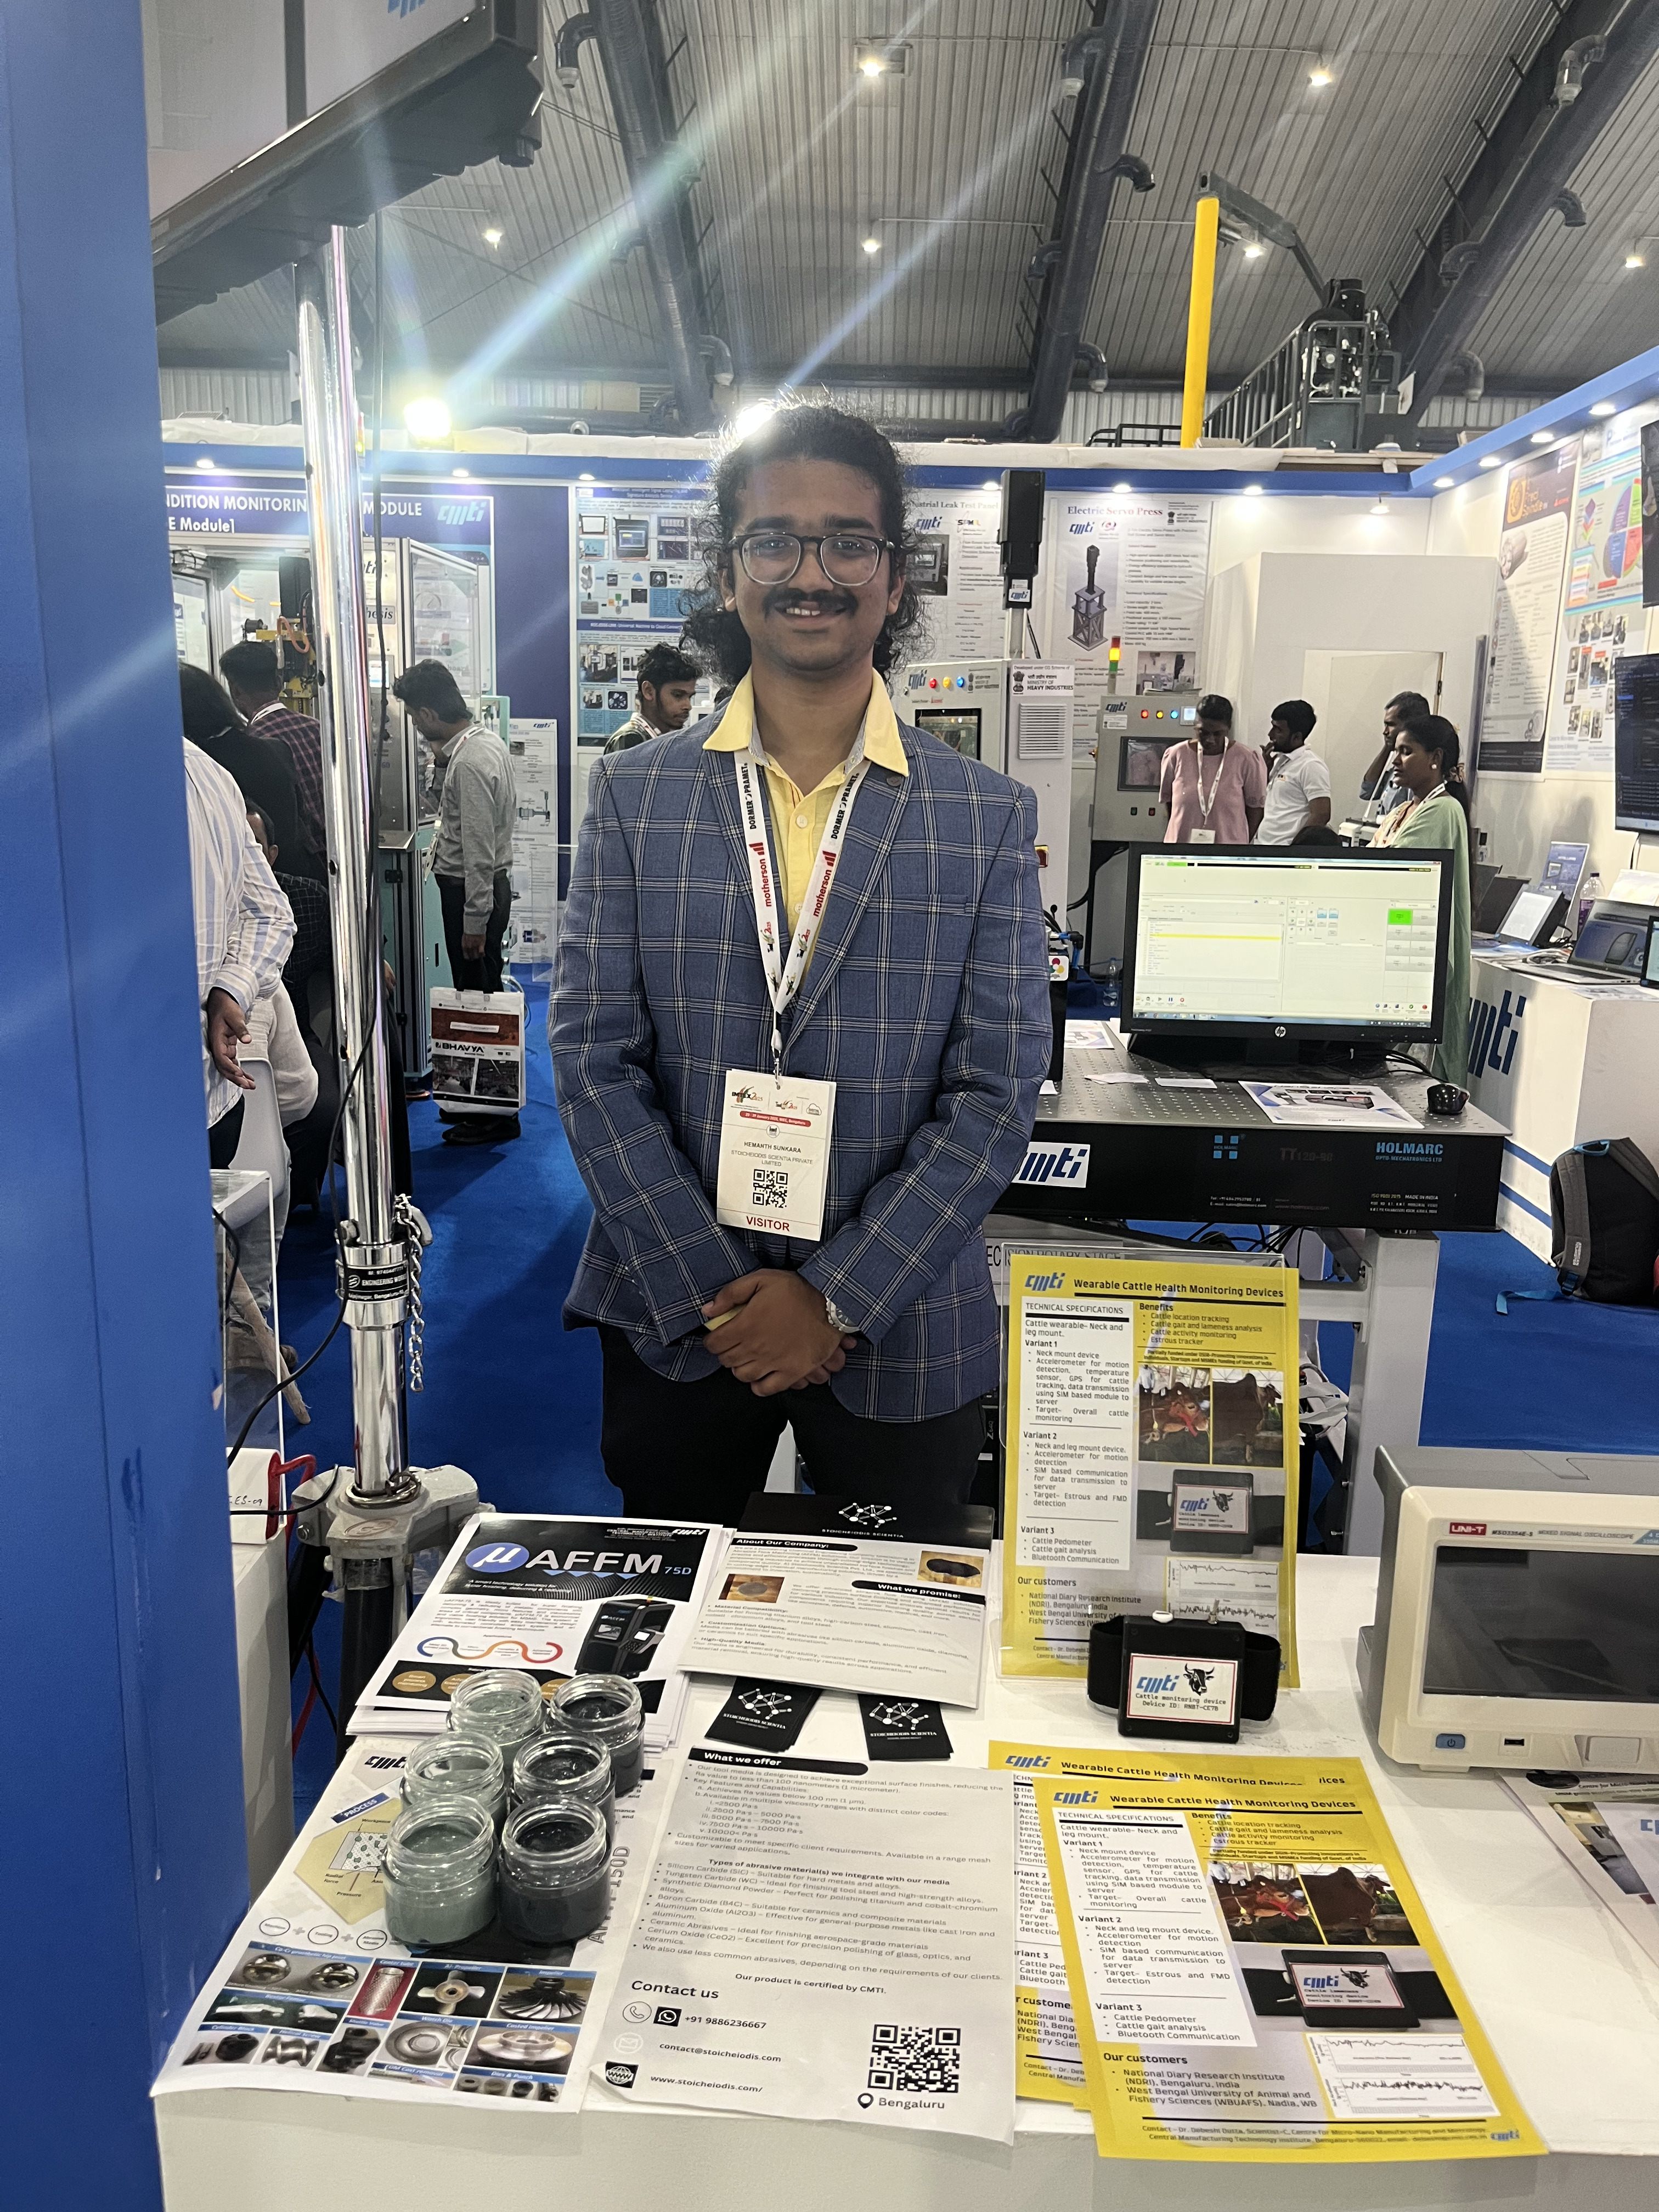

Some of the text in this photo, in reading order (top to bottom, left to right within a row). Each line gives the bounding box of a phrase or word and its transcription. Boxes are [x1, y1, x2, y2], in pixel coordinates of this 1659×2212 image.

[224, 496, 308, 512] MONITORIN
[1068, 506, 1163, 516] Electric Servo Press
[437, 501, 487, 525] cmti
[1069, 522, 1093, 535] cmti
[1010, 590, 1028, 601] cmti
[1105, 702, 1127, 712] cmti
[746, 800, 757, 830] DORMER
[831, 810, 845, 839] DORMER
[759, 859, 772, 907] motherson
[813, 870, 832, 917] motherson
[1275, 1028, 1285, 1037] hp
[1467, 989, 1526, 1079] mti
[442, 1043, 484, 1053] BHAVYA
[1376, 1142, 1443, 1155] HOLMARC
[1018, 1148, 1088, 1182] mti
[746, 1216, 789, 1232] VISITOR
[1025, 1272, 1065, 1291] cmti
[1074, 1279, 1284, 1297] Wearable Cattle Health Monitoring Devices
[1066, 1305, 1123, 1314] SPECIFICATIONS
[1139, 1303, 1173, 1311] Benefits
[1173, 1322, 1186, 1330] gait
[1021, 1526, 1048, 1534] Variant
[1451, 1525, 1485, 1534] UNI-T
[525, 1549, 663, 1573] AFFM
[664, 1566, 692, 1575] 75D
[1067, 1555, 1119, 1564] Communication
[922, 1588, 961, 1599] promise:
[1136, 1675, 1180, 1693] cmti
[1162, 1696, 1200, 1704] monitoring
[364, 1756, 408, 1769] cmt
[704, 1752, 733, 1763] What
[753, 1757, 782, 1767] offer
[1005, 1755, 1052, 1769] cmti
[1053, 1790, 1099, 1804] cmti
[1110, 1795, 1164, 1805] Wearable
[1205, 1797, 1243, 1807] Health
[1245, 1800, 1308, 1809] Monitoring
[1311, 1800, 1356, 1809] Devices
[344, 1799, 377, 1818] PROCESS
[650, 1918, 729, 1932] Ceramic Abrasives
[631, 1980, 720, 2000] Contact us
[754, 1975, 792, 1985] product
[804, 1979, 843, 1990] certified
[845, 1984, 857, 1993] by
[685, 2015, 767, 2030] +91 9886236667
[659, 2042, 782, 2063] contact@stoicheiodis.com
[1103, 2053, 1188, 2064] Our customers
[1123, 2069, 1164, 2078] National
[1167, 2070, 1192, 2080] Diary
[650, 2074, 763, 2093] www.stoicheiodis.com/
[1127, 2086, 1153, 2094] West
[1155, 2087, 1189, 2097] Bengal
[1191, 2089, 1241, 2098] University
[879, 2097, 945, 2111] Bengaluru
